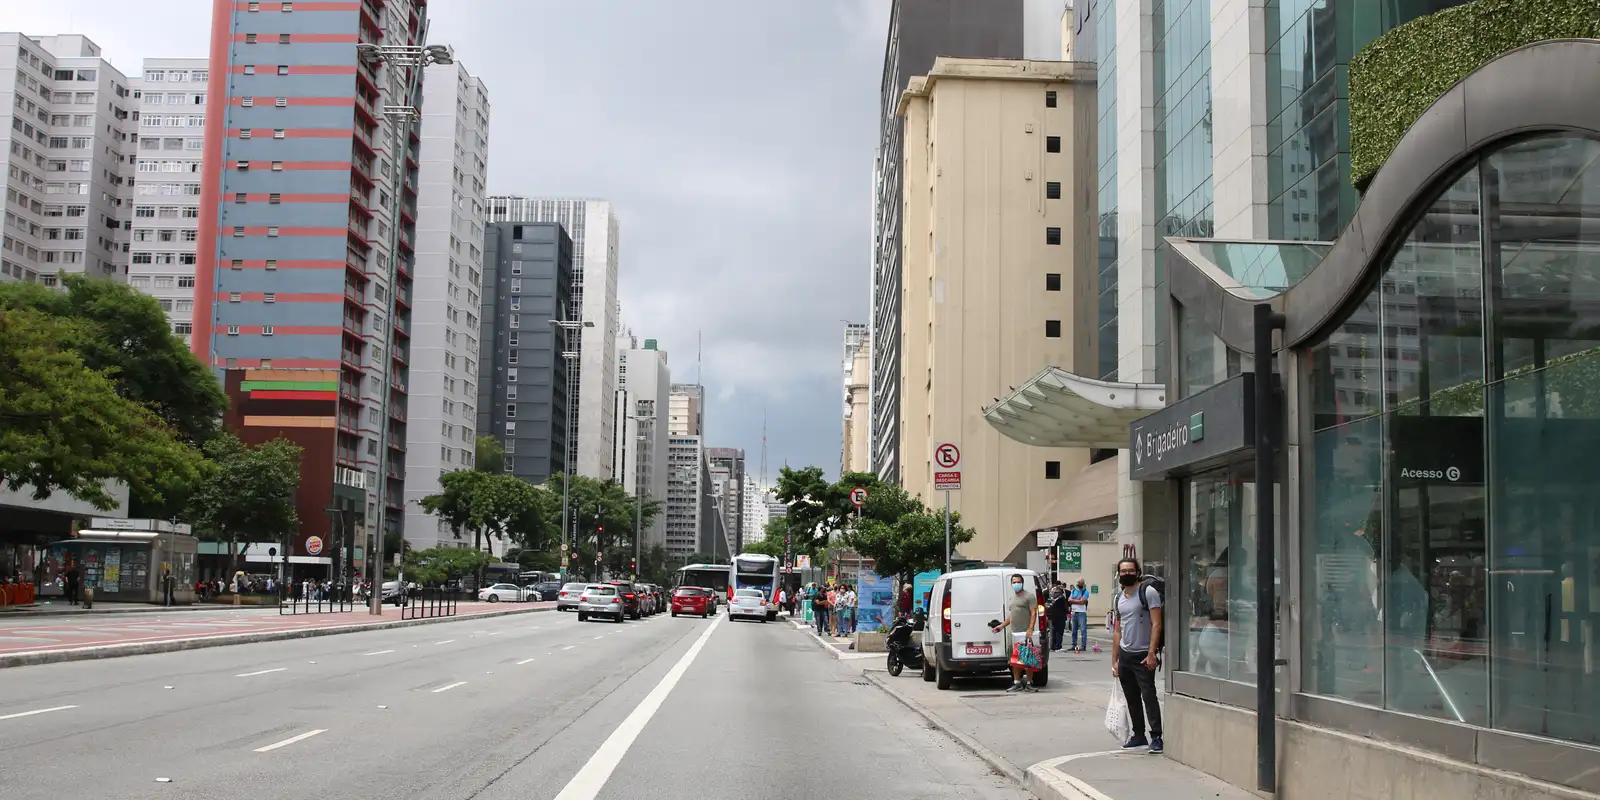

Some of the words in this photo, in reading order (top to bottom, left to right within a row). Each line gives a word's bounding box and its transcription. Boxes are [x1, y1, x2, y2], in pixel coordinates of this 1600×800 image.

[1146, 420, 1188, 461] Brigadeiro
[1400, 467, 1443, 479] Acesso
[1446, 466, 1461, 481] G
